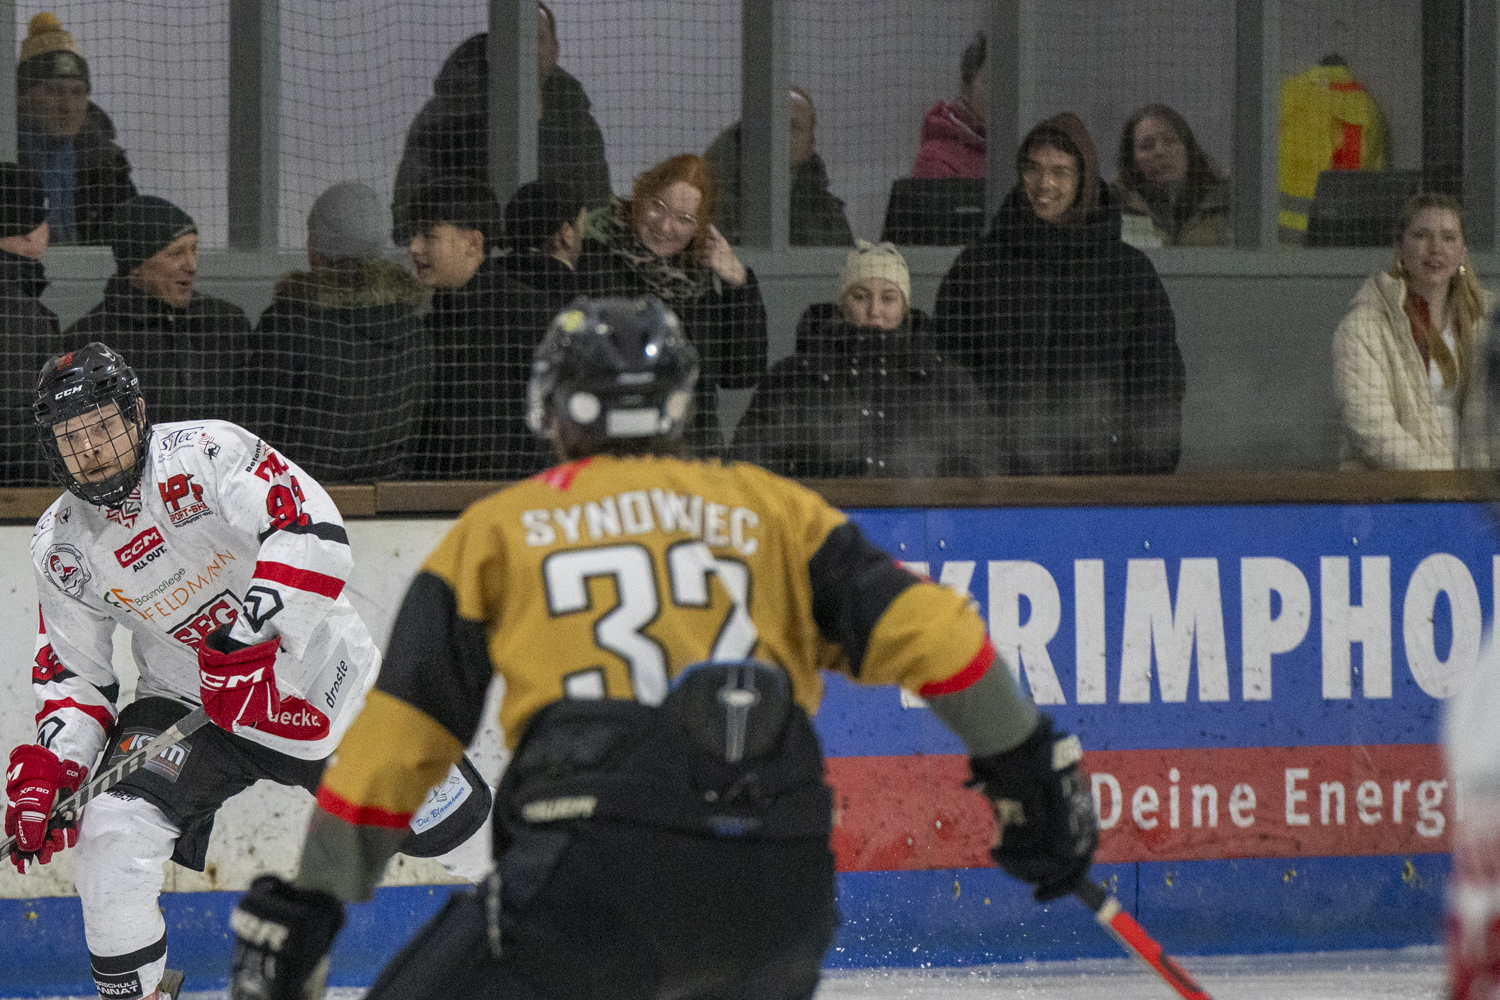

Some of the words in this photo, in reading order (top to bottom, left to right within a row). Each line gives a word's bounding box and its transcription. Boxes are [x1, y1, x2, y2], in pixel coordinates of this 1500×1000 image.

[54, 384, 83, 401] CCM
[120, 532, 159, 563] CCM
[132, 560, 148, 573] ALL
[134, 567, 186, 607] Baumpflege
[543, 541, 759, 707] 32
[895, 553, 1500, 708] RIMPHO
[325, 659, 349, 709] droste
[1092, 768, 1257, 830] Deine
